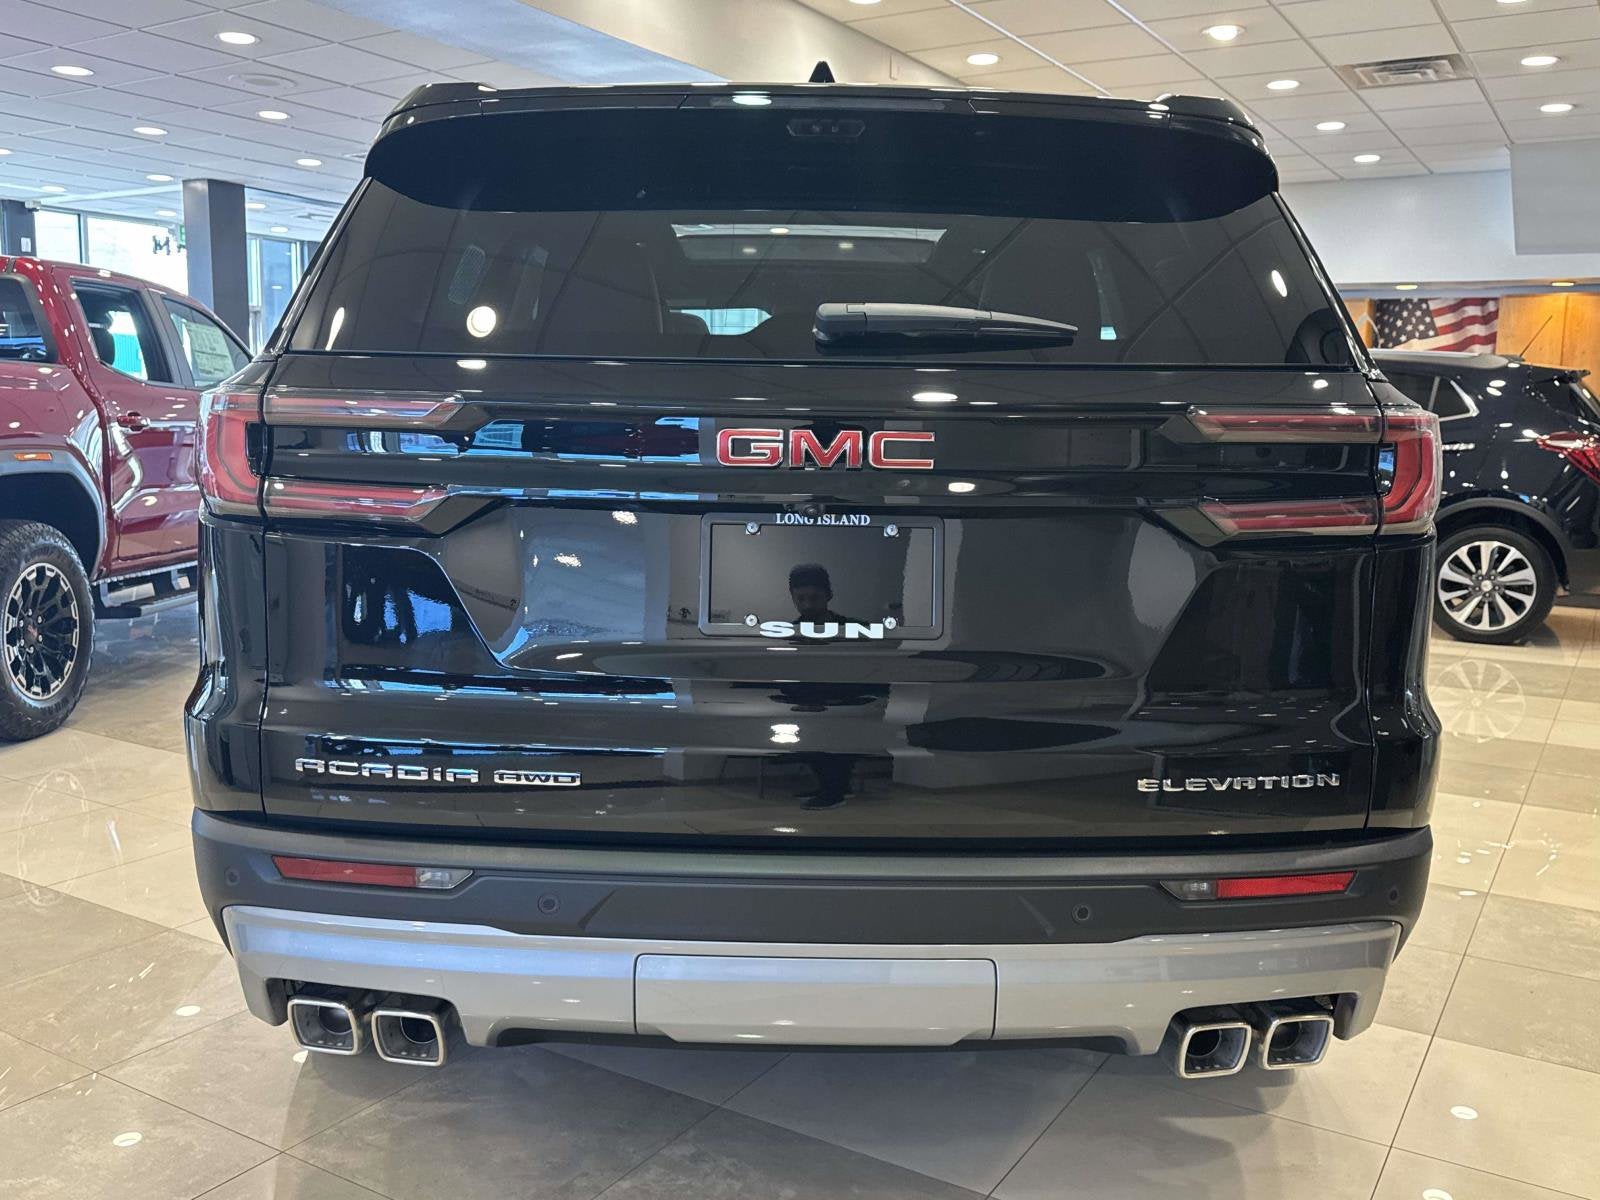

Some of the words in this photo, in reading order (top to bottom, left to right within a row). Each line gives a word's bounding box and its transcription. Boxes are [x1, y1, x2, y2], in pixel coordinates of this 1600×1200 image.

[717, 428, 935, 470] GMC
[776, 513, 814, 525] LONG
[816, 514, 871, 526] ISLAND
[760, 621, 884, 639] SUN
[295, 758, 479, 783] ACADIA
[494, 770, 582, 786] AWD
[1137, 773, 1341, 792] ELEVATION
